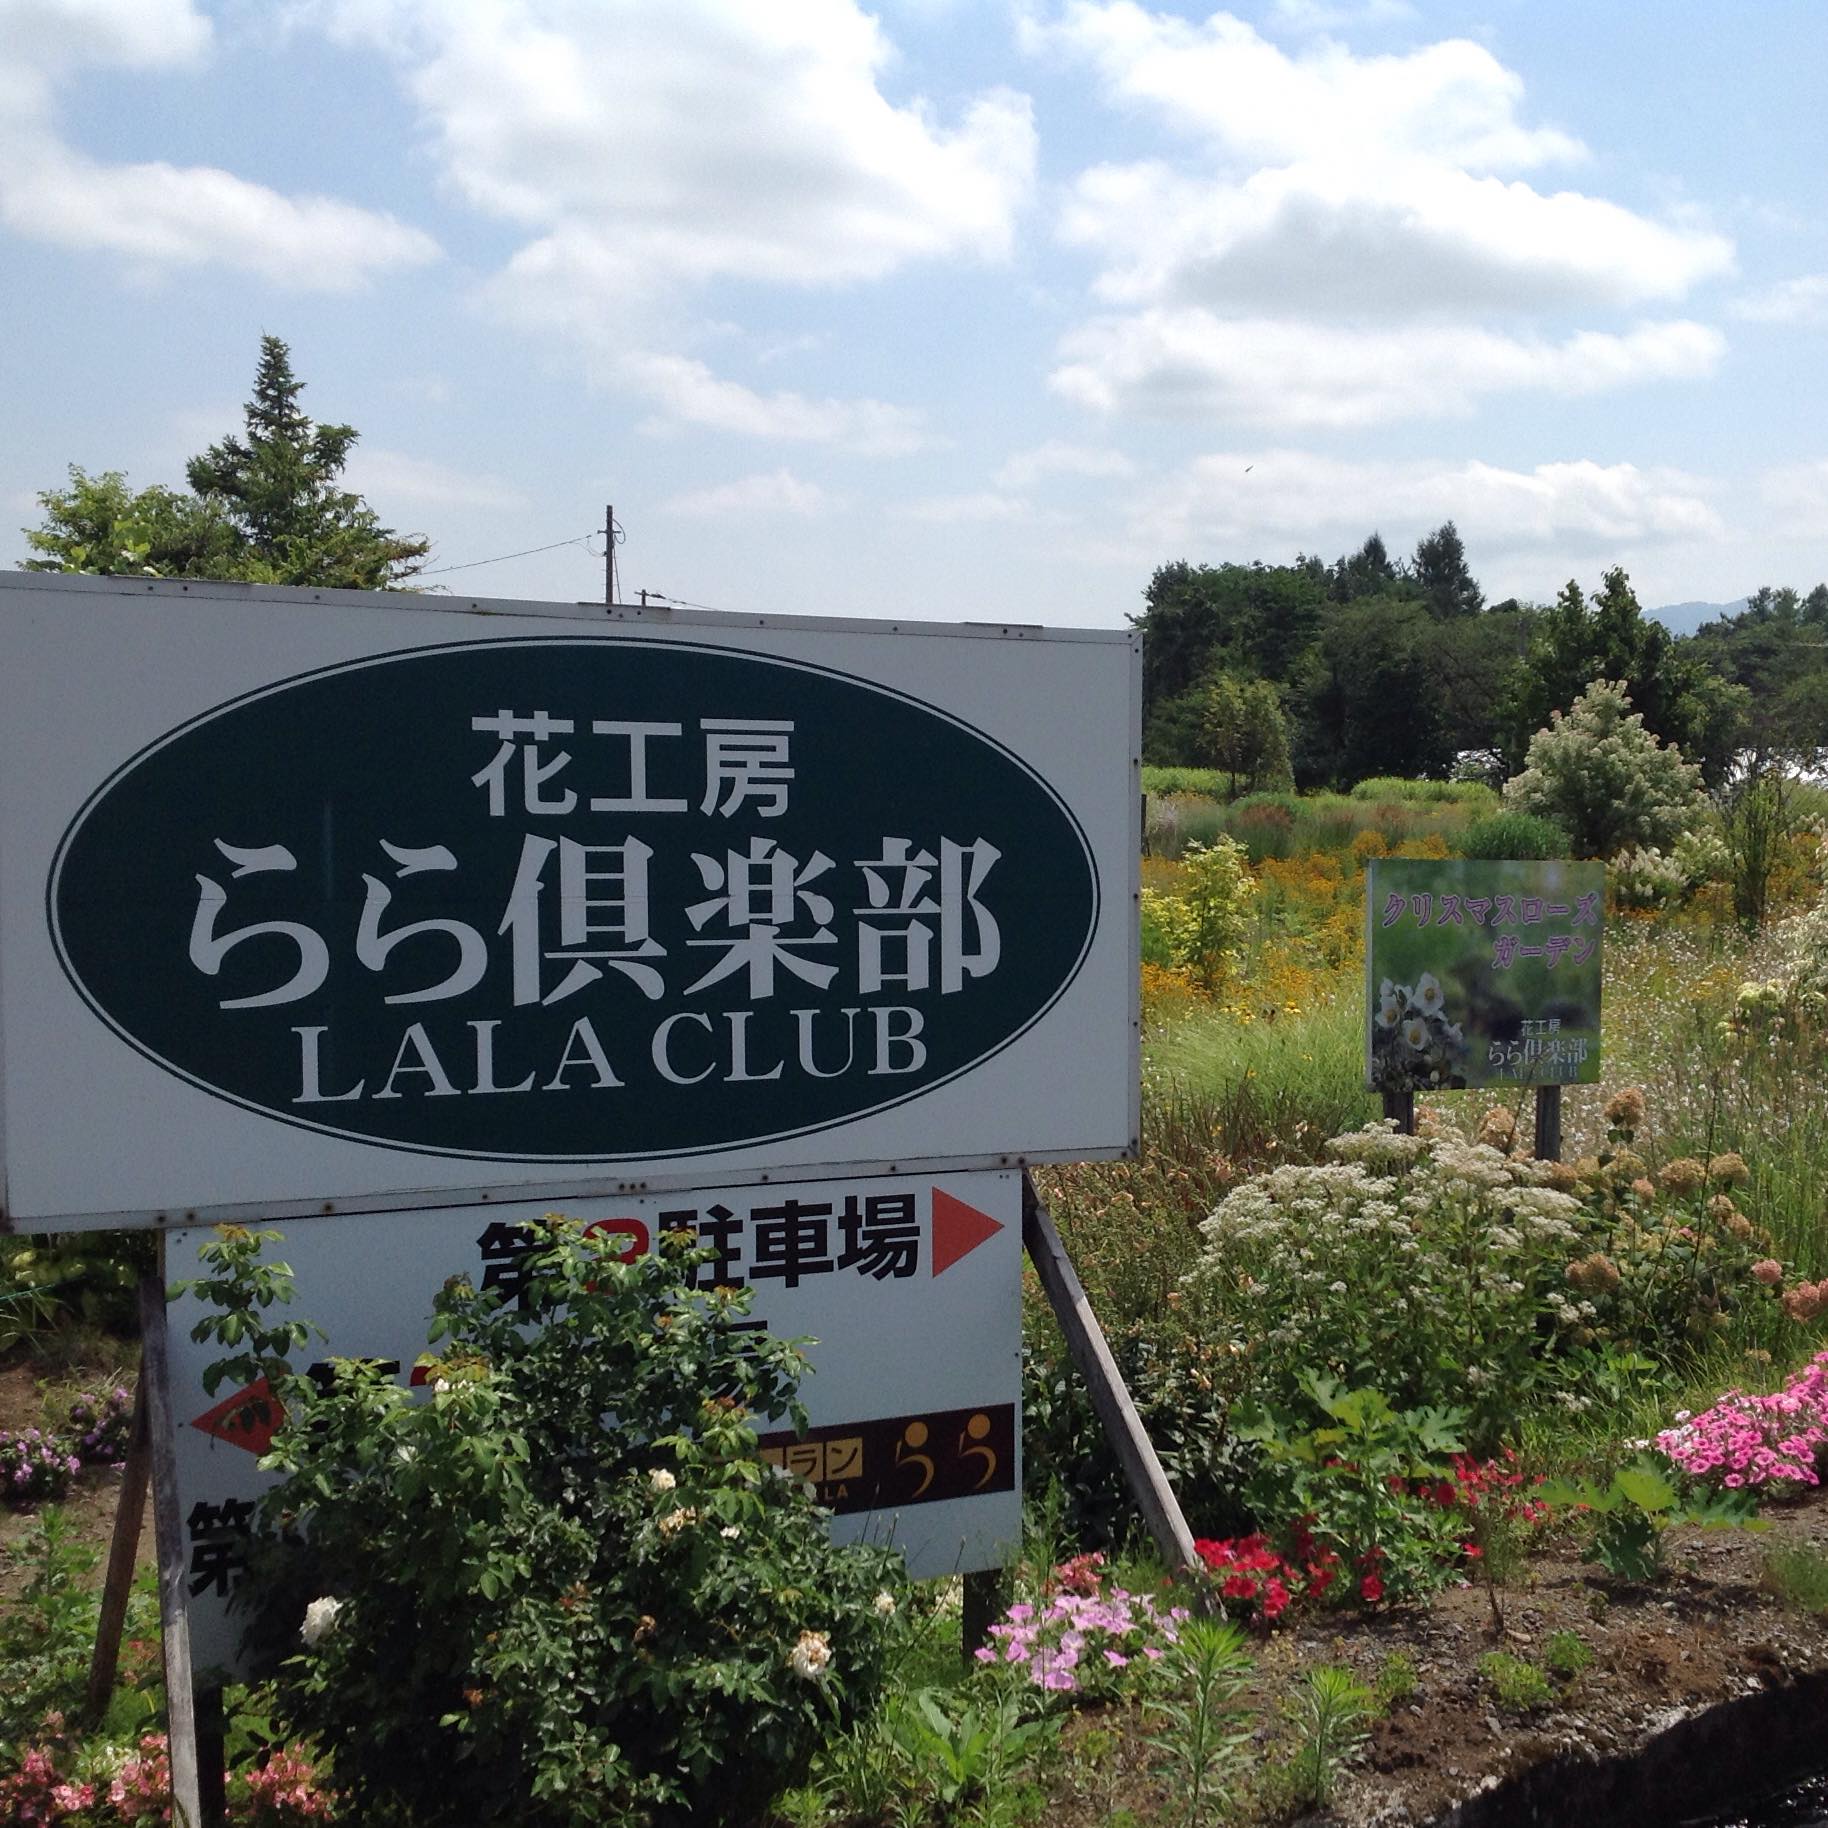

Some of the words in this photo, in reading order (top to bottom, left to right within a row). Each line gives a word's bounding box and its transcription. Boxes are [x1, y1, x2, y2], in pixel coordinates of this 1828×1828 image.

[471, 709, 796, 817] 花工房
[189, 833, 1002, 1010] らら倶楽部
[1382, 892, 1599, 928] クリスマスローズ
[1492, 934, 1596, 969] ガーデン
[291, 1019, 625, 1103] LALA
[651, 1007, 928, 1087] CLUB
[1520, 1018, 1561, 1037] 花工房
